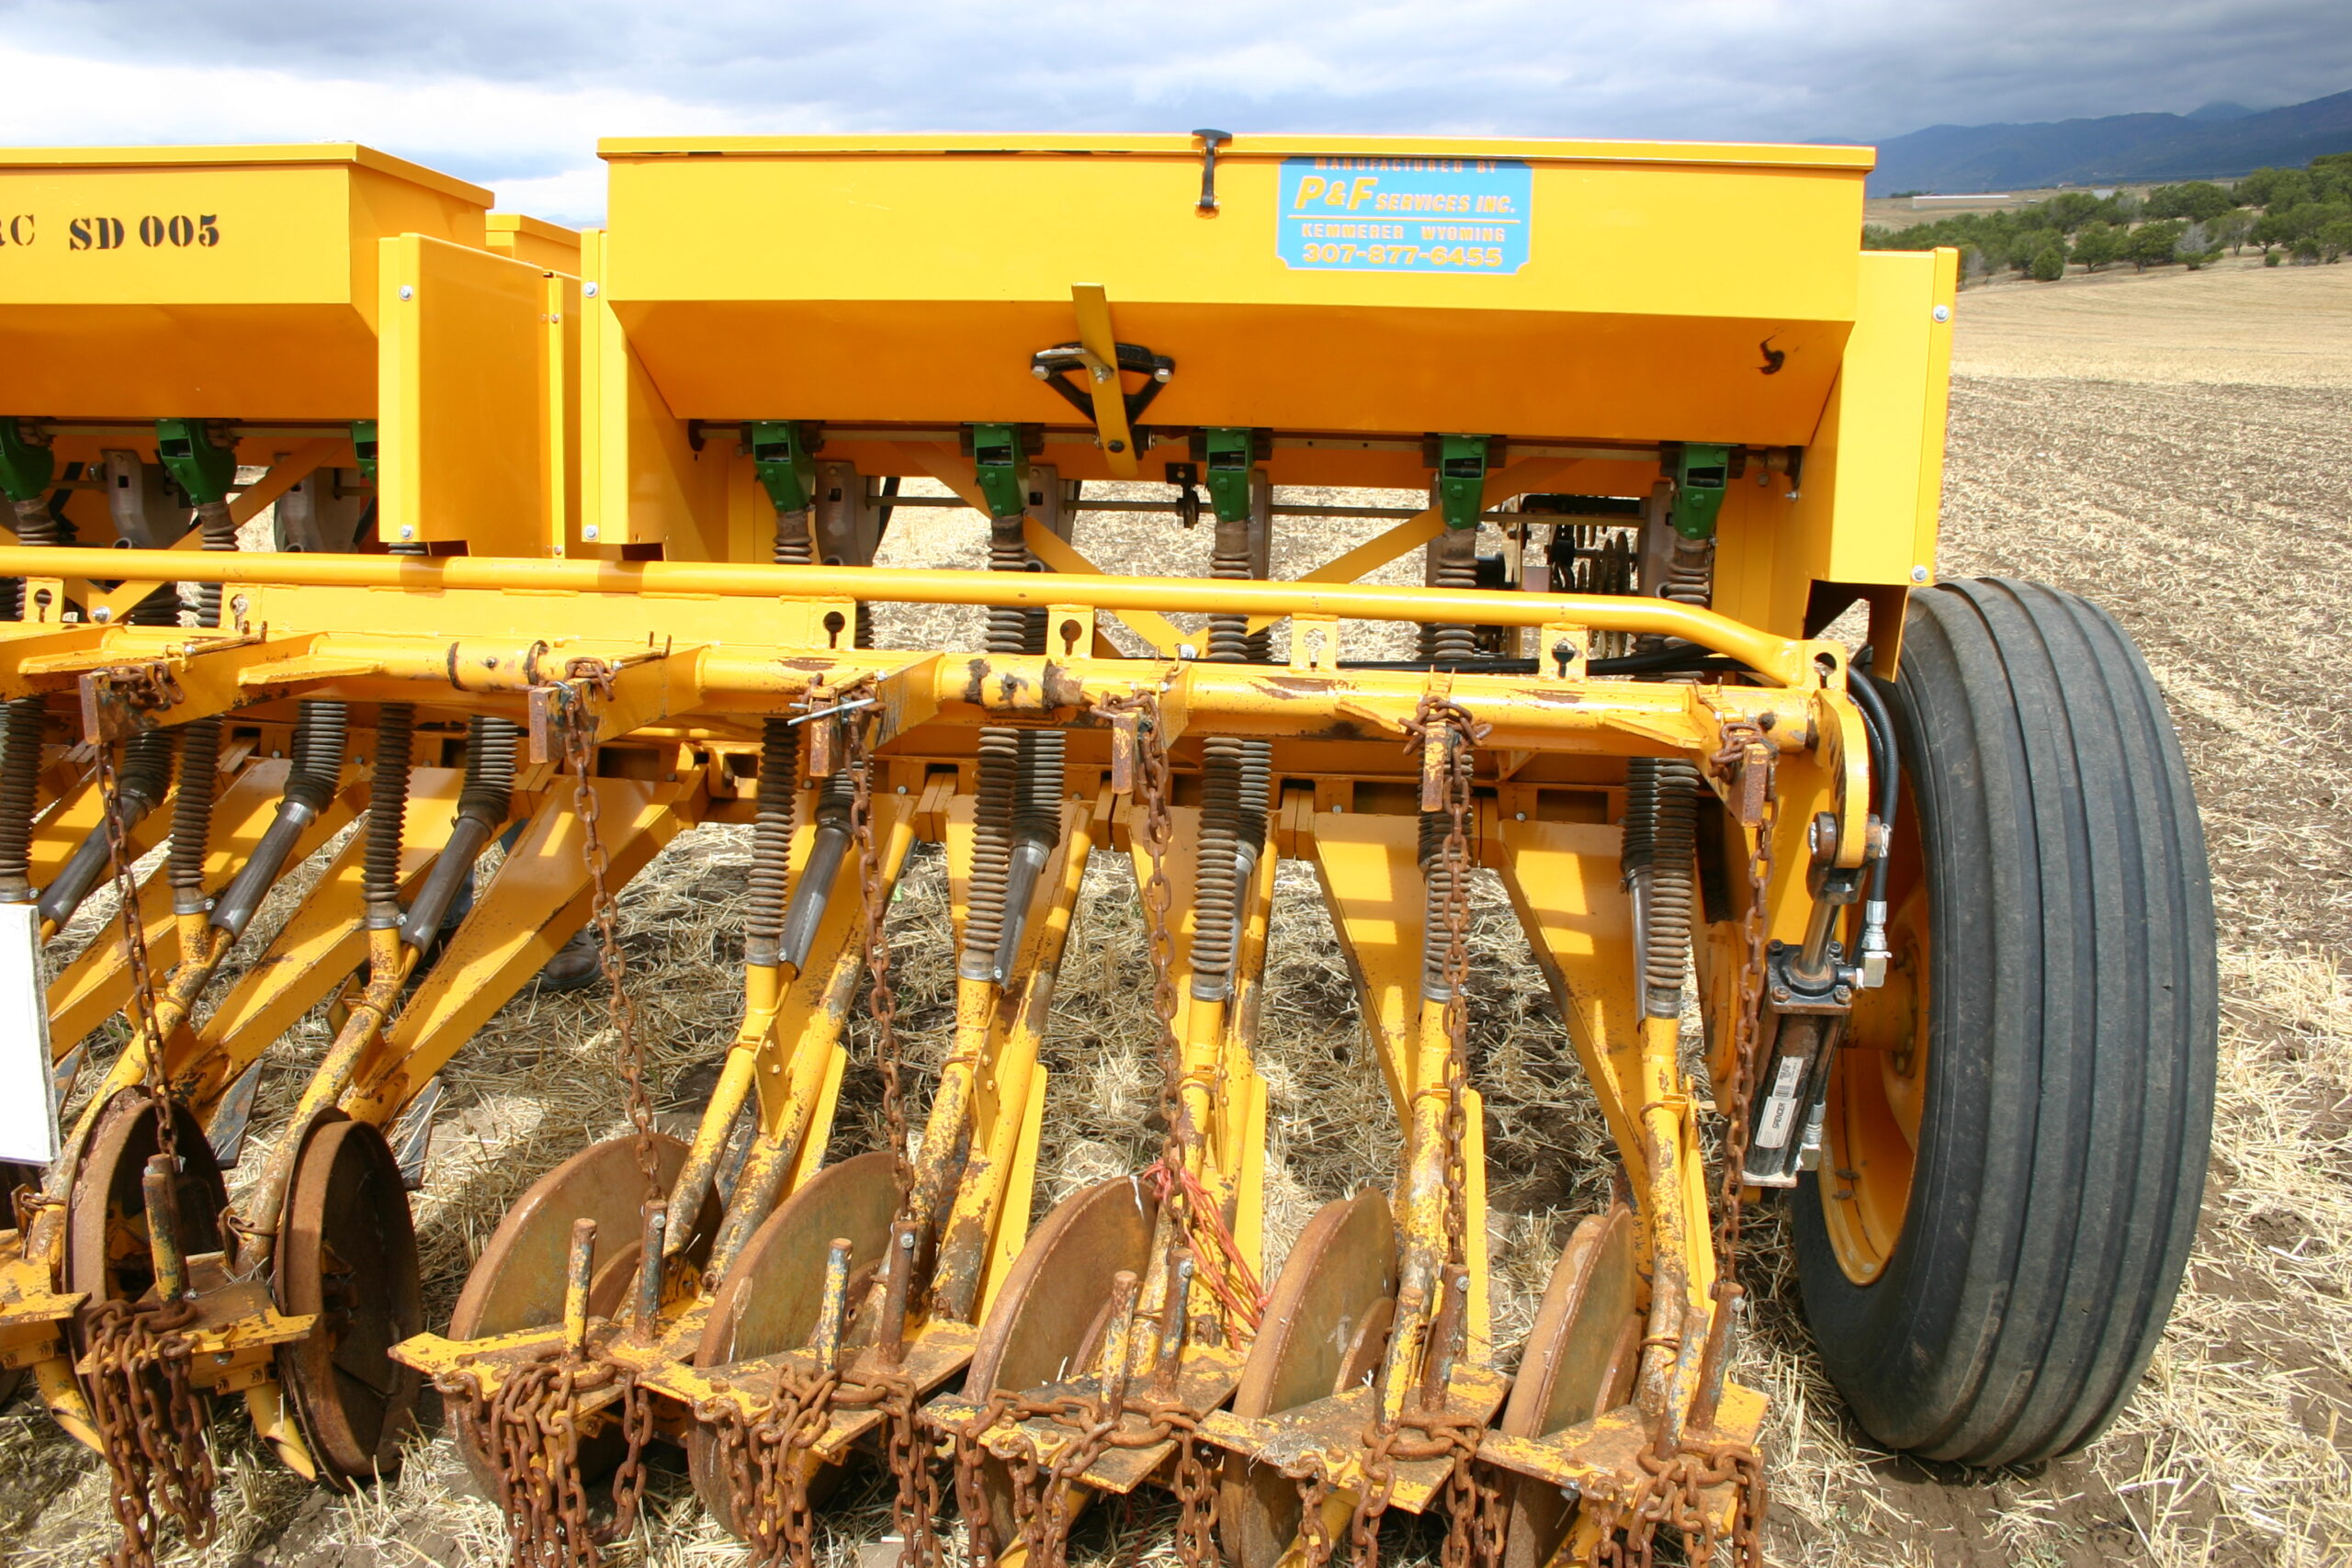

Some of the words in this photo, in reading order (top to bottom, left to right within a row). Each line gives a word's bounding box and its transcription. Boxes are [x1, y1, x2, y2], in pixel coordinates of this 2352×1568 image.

[1315, 157, 1463, 173] MANUFACTURED
[1476, 159, 1498, 174] BY
[1294, 175, 1379, 210] P&F
[1374, 193, 1471, 214] SERVICES
[1475, 195, 1516, 214] INC.
[0, 214, 35, 246] C
[69, 217, 125, 251] SD
[140, 214, 220, 247] 005
[1301, 223, 1404, 240] KEMMERER
[1421, 225, 1506, 243] WYOMING
[1303, 243, 1503, 267] 307-877-6455
[1772, 1102, 1786, 1129] SPENCER
